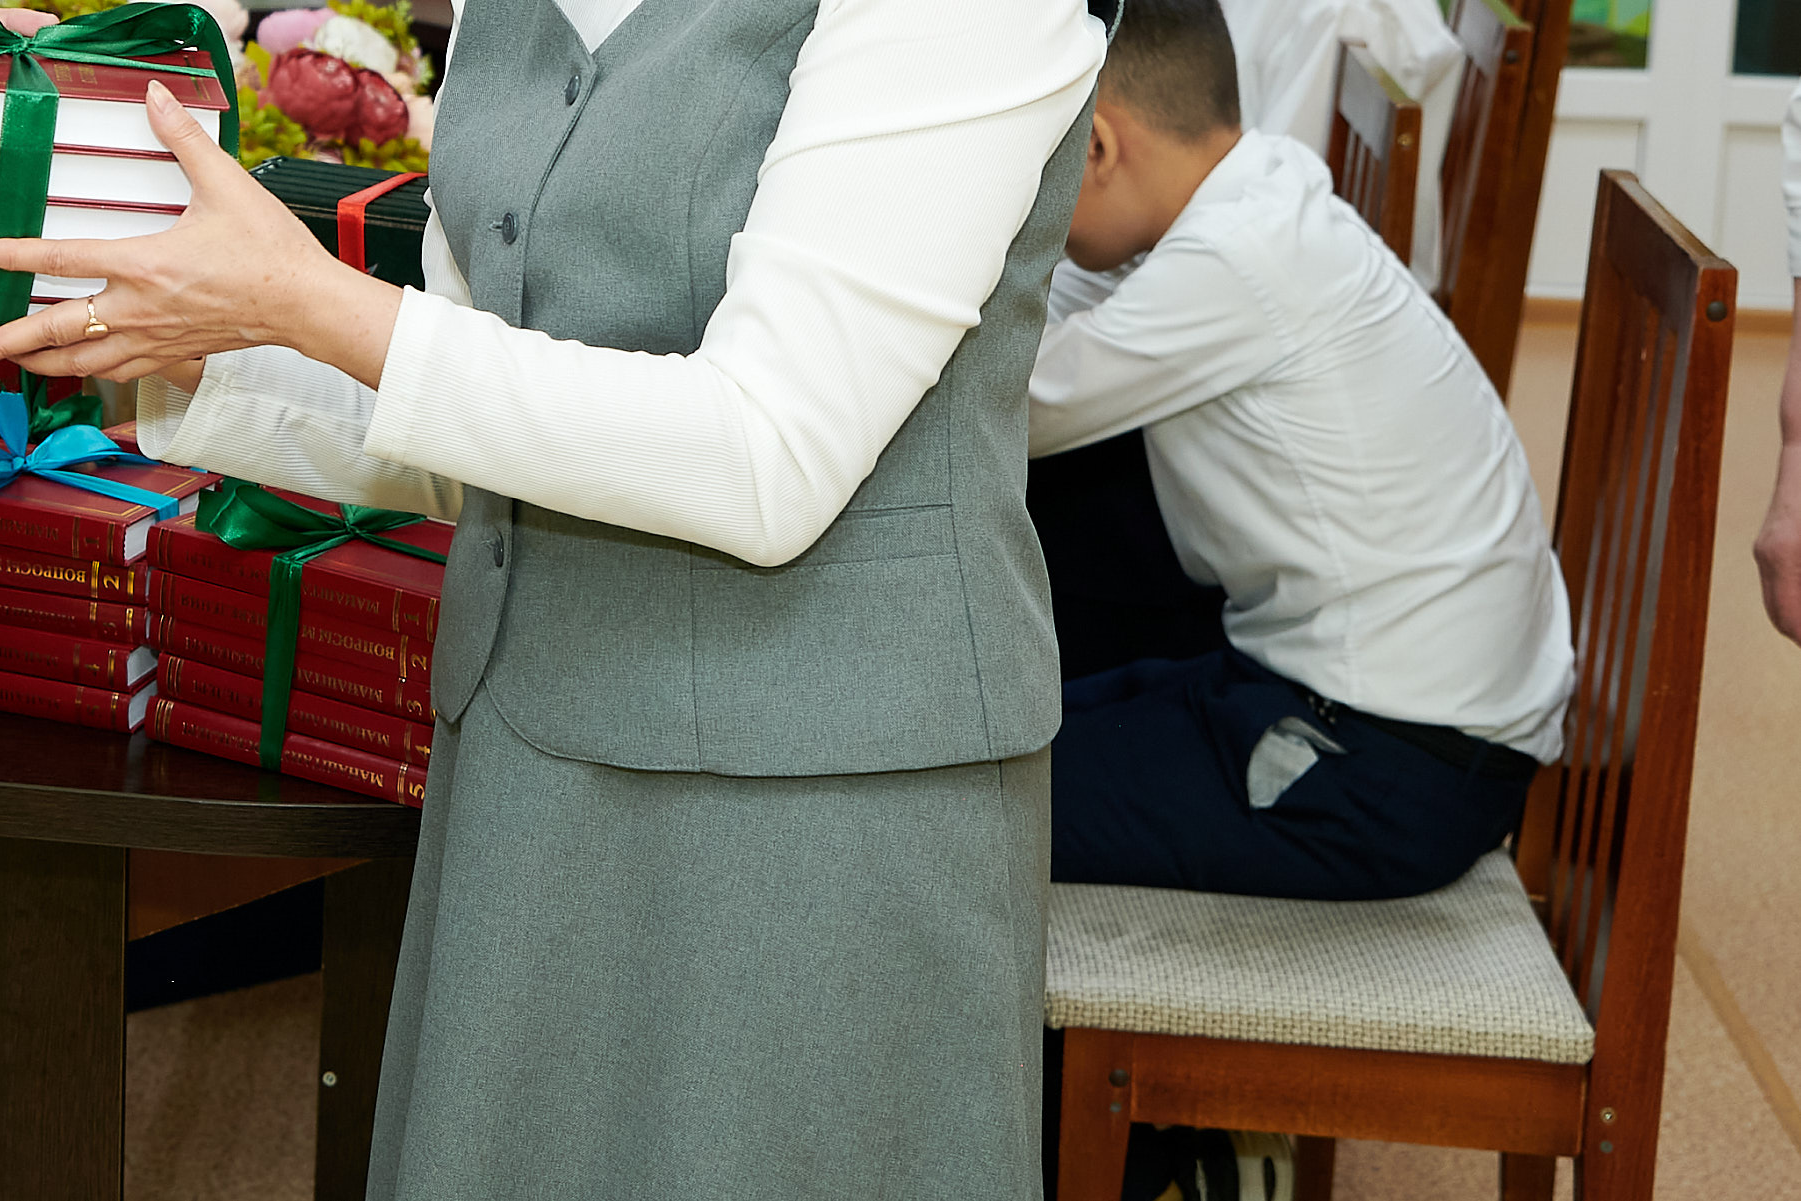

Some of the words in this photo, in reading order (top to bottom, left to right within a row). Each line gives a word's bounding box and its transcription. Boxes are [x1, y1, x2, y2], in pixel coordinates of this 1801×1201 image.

[103, 574, 121, 591] 2
[410, 653, 428, 672] 2
[406, 698, 424, 717] 3
[408, 781, 426, 800] 5
